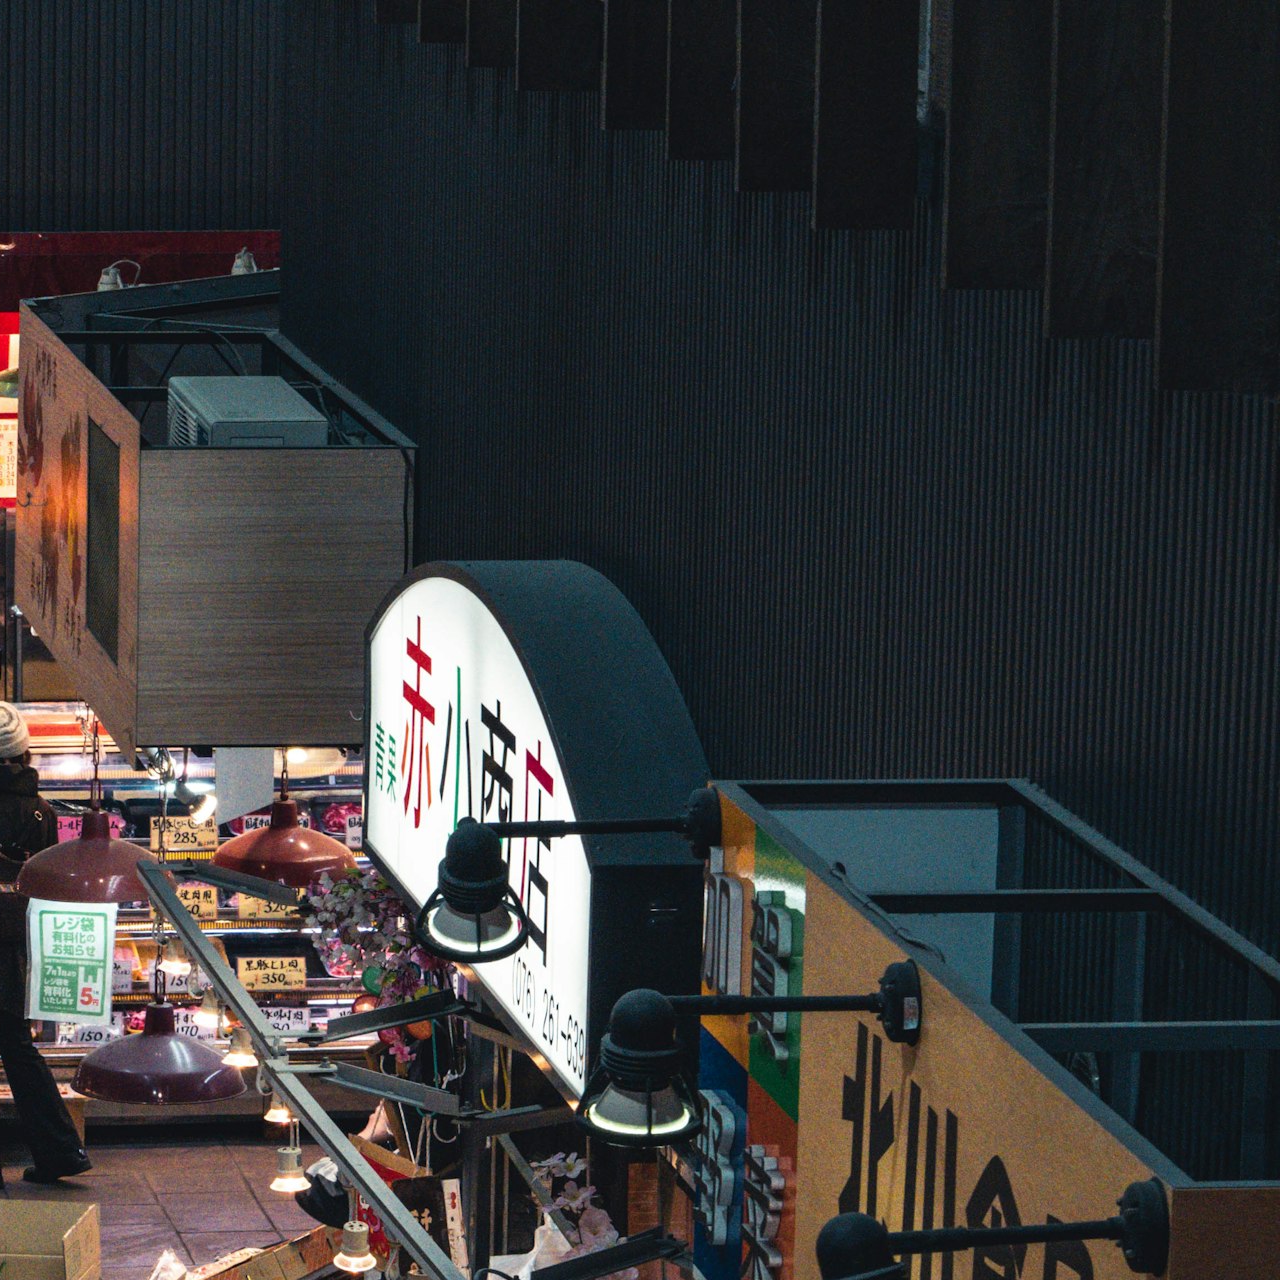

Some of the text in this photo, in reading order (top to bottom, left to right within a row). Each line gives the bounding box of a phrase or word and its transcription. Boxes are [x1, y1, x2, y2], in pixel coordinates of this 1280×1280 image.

[53, 916, 95, 932] レジ袋
[52, 931, 96, 944] 有料化の
[52, 945, 96, 957] お知らせ
